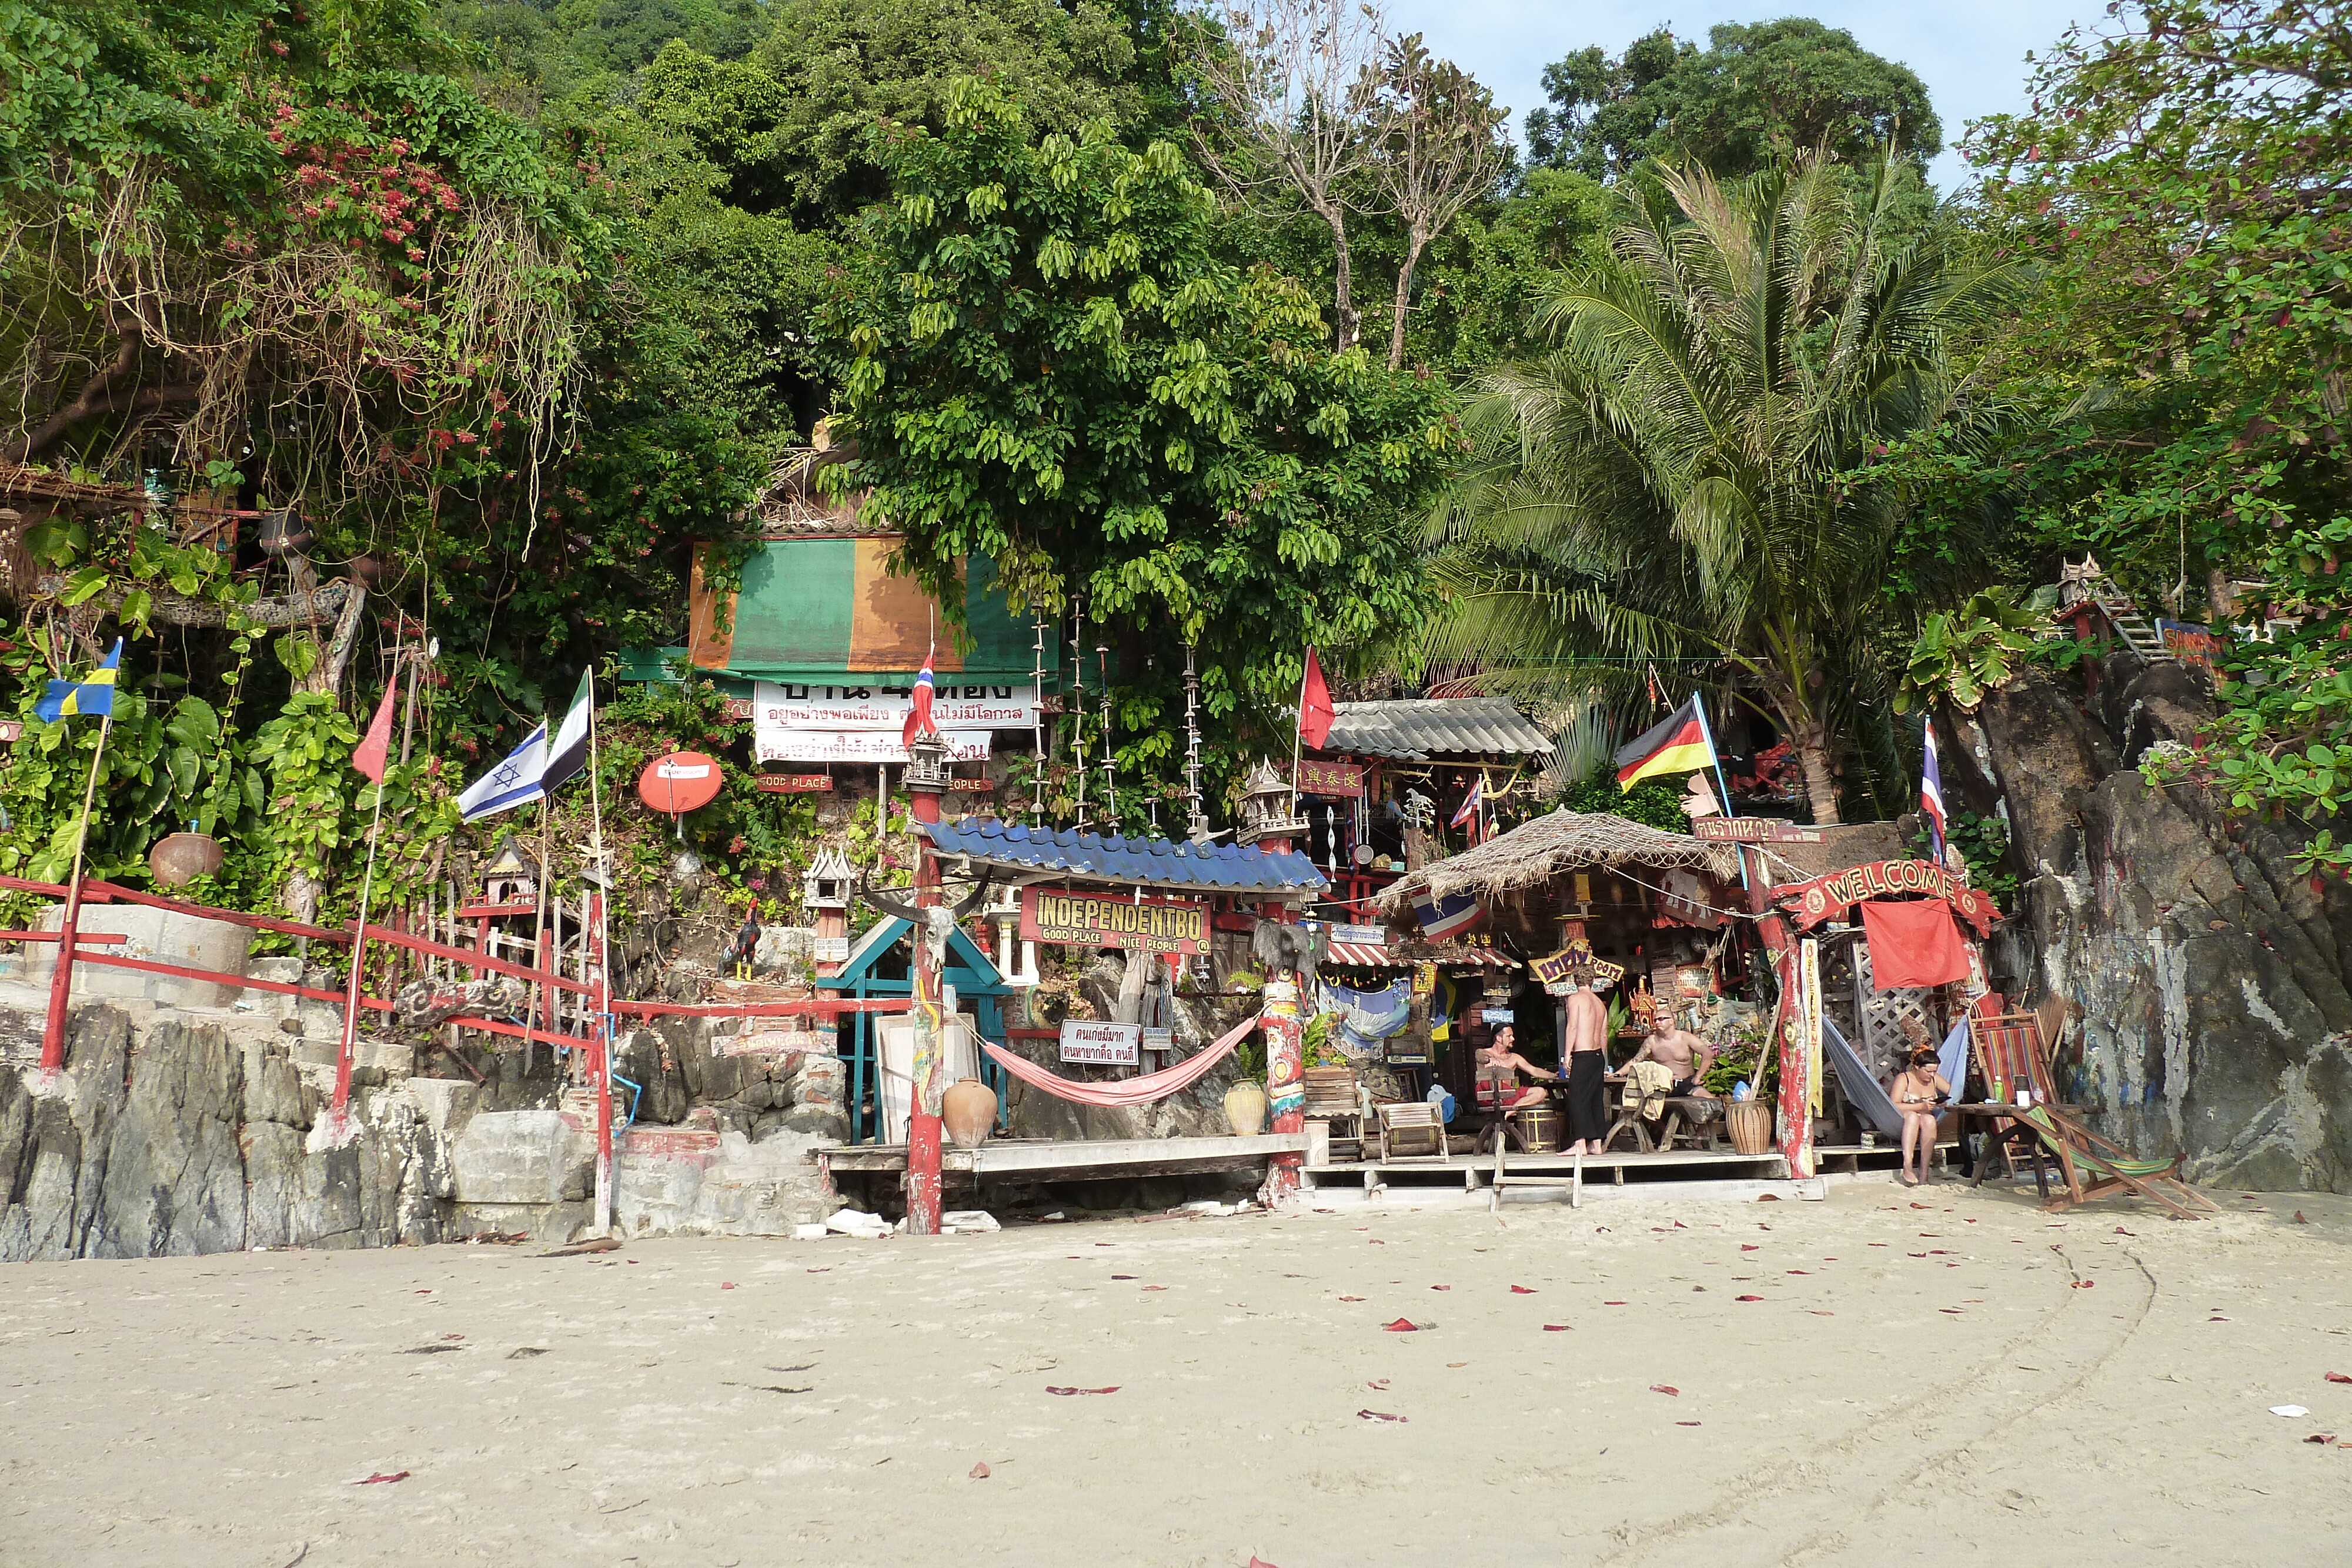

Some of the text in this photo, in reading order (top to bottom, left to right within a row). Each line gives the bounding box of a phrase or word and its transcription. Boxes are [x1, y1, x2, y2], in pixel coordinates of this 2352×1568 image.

[792, 777, 827, 788] PLACE
[948, 780, 981, 790] EOPLE
[1825, 861, 1956, 906] WELCOME
[1042, 928, 1069, 941] GOOD
[1072, 930, 1101, 944] PLACE
[1145, 938, 1179, 952] PEOPLE
[1591, 958, 1622, 979] ROOM
[1075, 1026, 1124, 1042] คนเก่งมีมาก
[1064, 1044, 1134, 1061] คนหายากคือ คนดี
